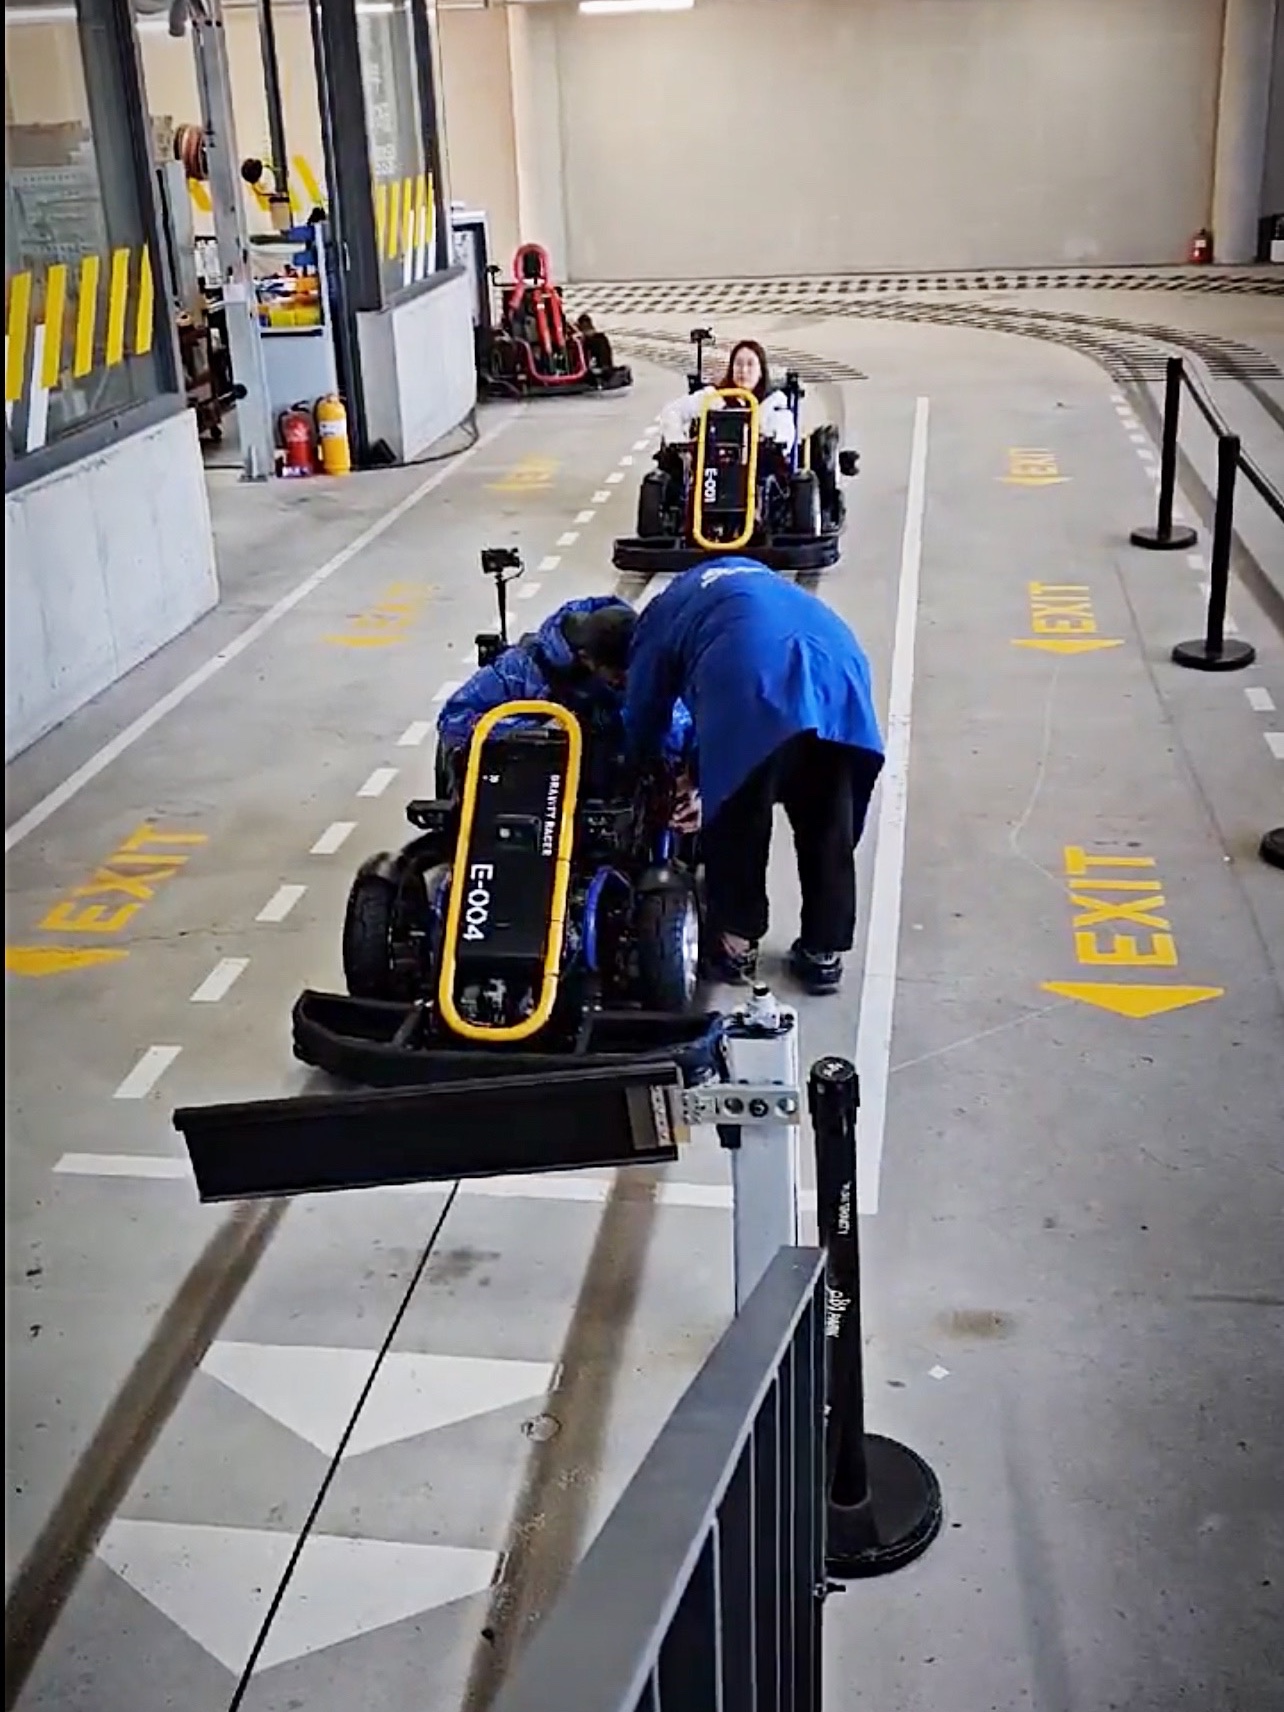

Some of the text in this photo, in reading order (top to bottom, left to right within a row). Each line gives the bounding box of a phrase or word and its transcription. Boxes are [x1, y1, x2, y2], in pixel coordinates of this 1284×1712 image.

[704, 467, 718, 503] E-001
[1029, 582, 1096, 634] EXIT
[541, 774, 560, 856] GRAVITY RACER
[38, 823, 208, 931] EXIT
[463, 864, 493, 941] E-004
[1064, 845, 1178, 966] EXIT
